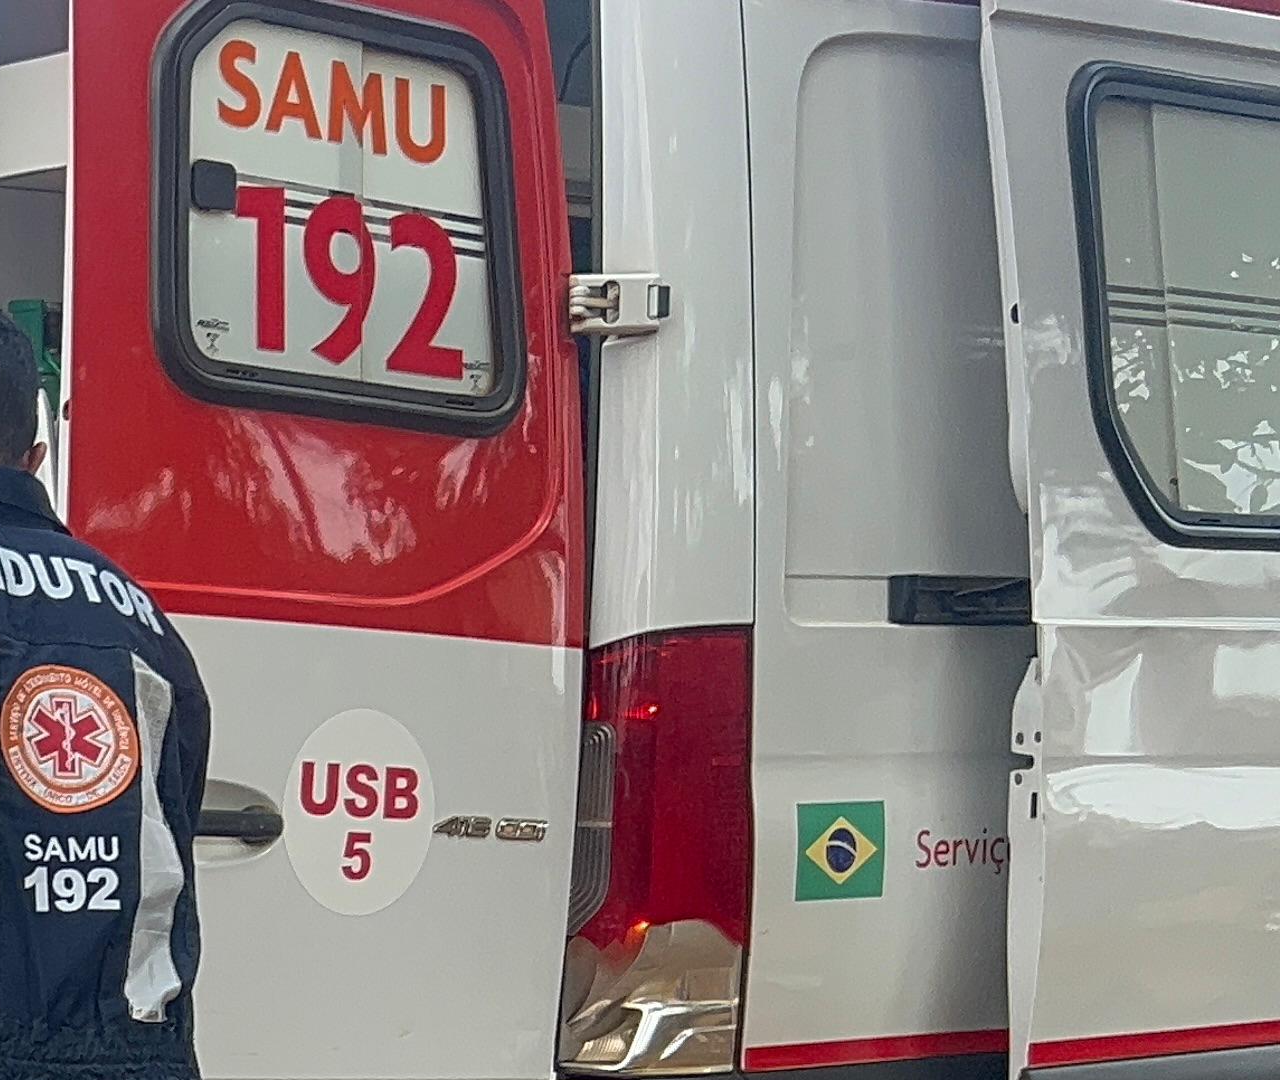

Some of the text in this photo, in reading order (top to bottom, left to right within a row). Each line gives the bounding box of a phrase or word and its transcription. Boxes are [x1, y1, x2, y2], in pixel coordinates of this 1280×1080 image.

[217, 39, 447, 164] SAMU
[235, 186, 464, 380] 192
[299, 761, 420, 820] USB
[24, 834, 119, 862] SAMU
[341, 832, 374, 882] 5
[24, 866, 121, 912] 192
